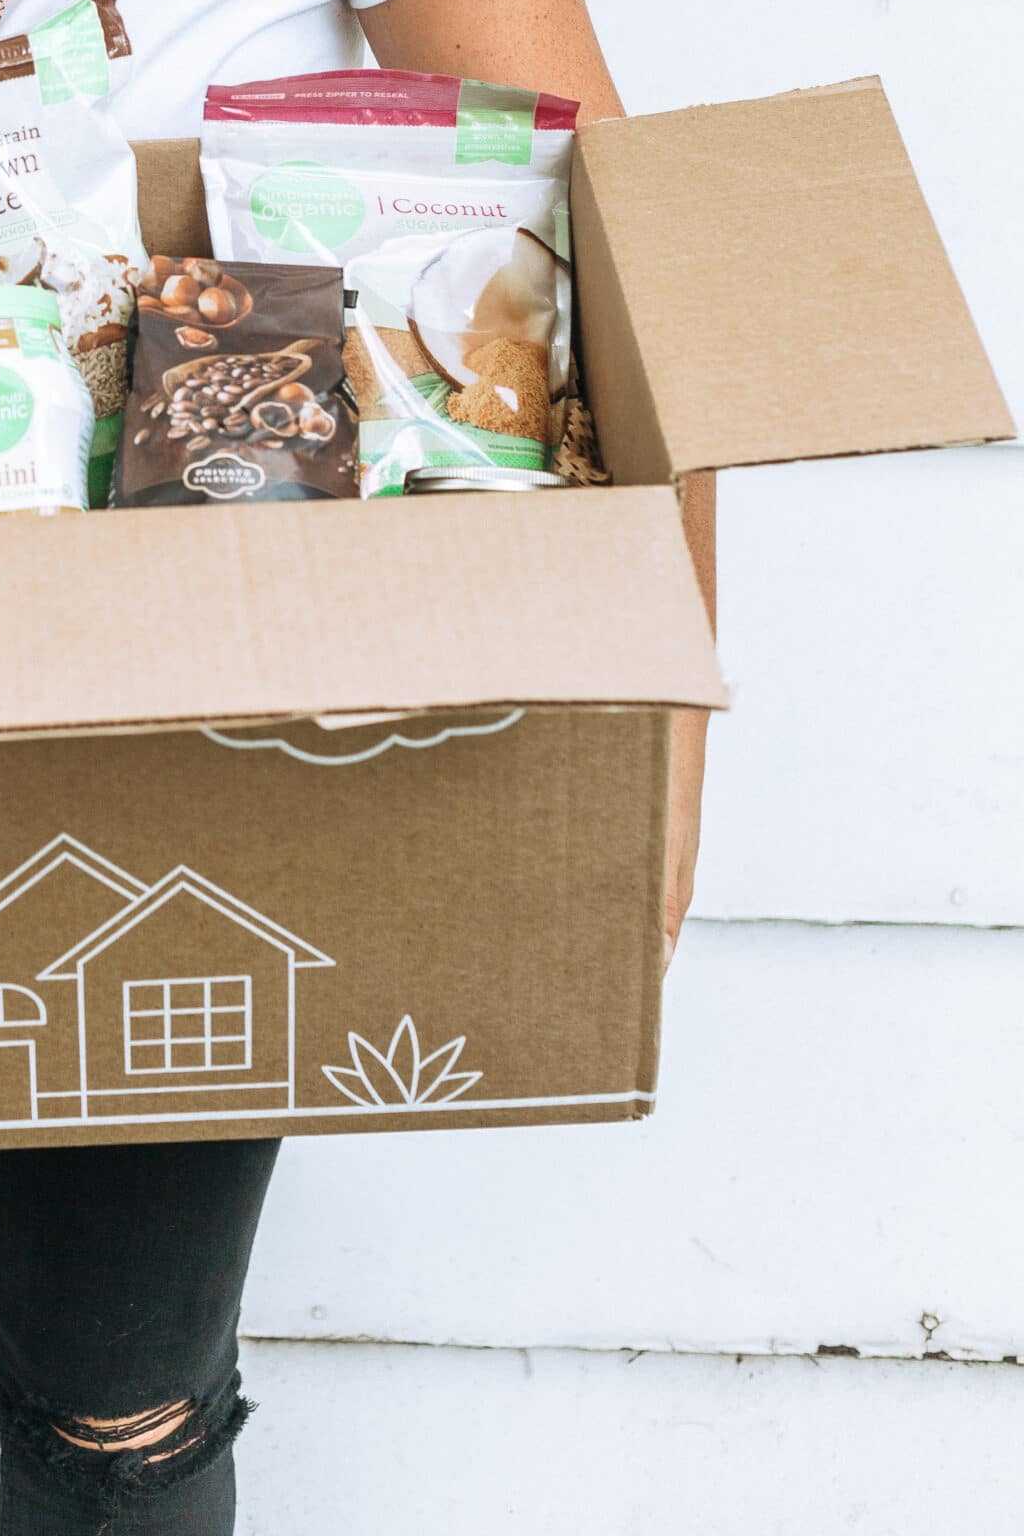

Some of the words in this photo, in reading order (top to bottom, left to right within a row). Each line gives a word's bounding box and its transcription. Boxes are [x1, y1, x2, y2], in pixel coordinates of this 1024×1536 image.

[294, 91, 323, 99] PRESS
[325, 91, 358, 99] ZIPPER
[359, 91, 372, 99] TO
[373, 91, 409, 100] RESEAL
[257, 189, 306, 205] simple
[260, 201, 359, 221] organic
[392, 197, 509, 219] Coconut
[396, 219, 451, 232] SUGAR
[194, 467, 252, 476] PRIVATE
[192, 476, 256, 484] SELECTION
